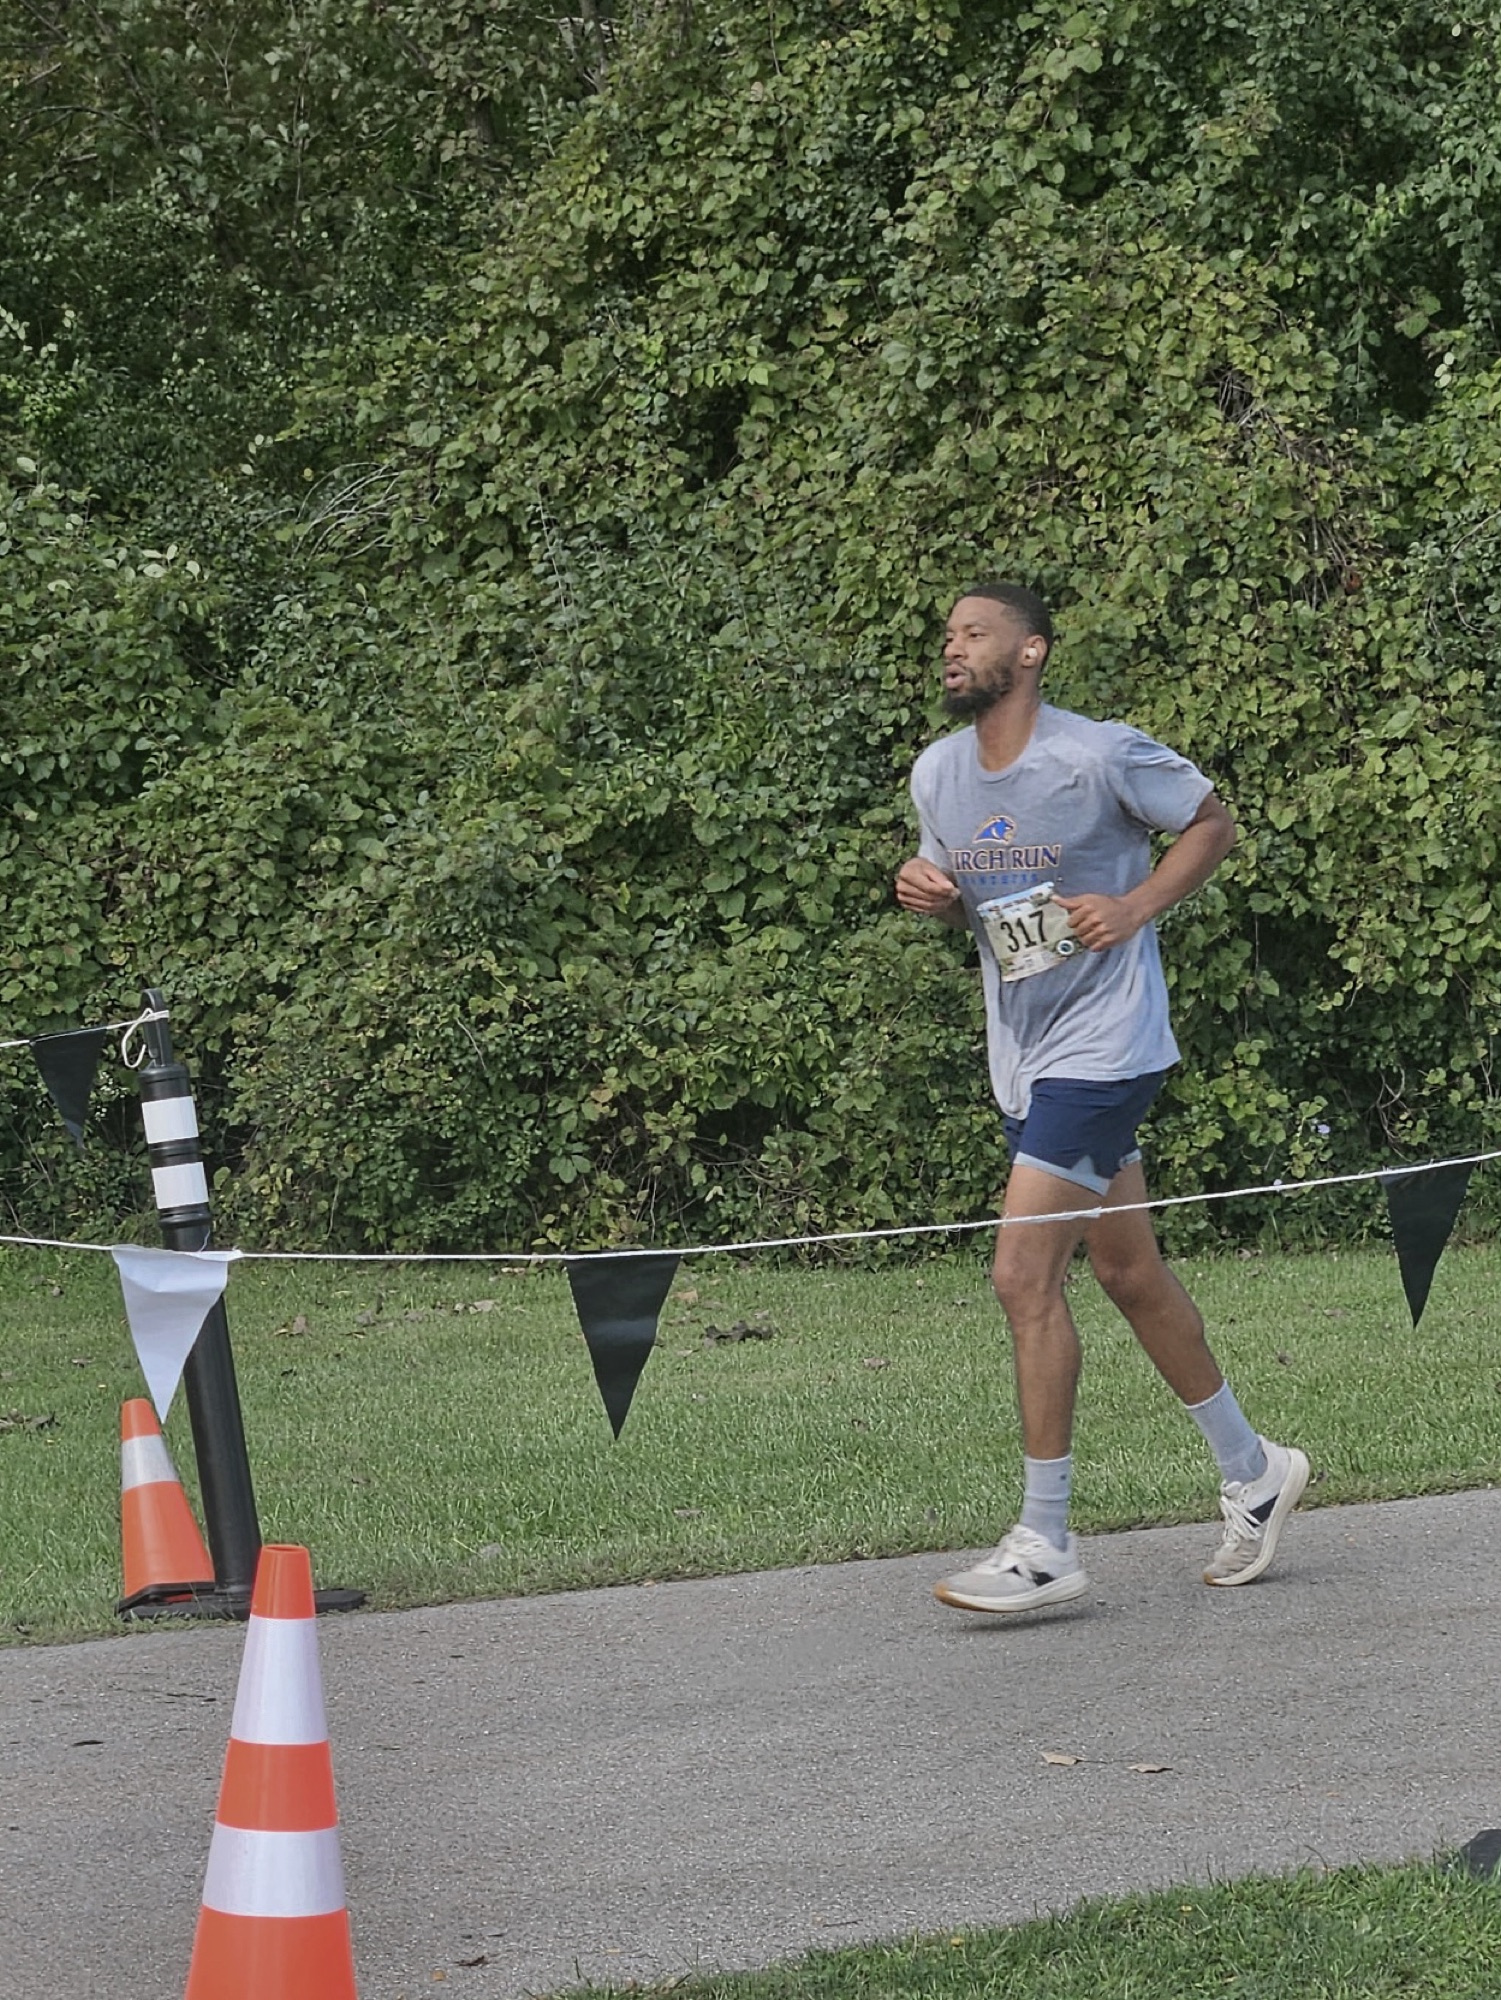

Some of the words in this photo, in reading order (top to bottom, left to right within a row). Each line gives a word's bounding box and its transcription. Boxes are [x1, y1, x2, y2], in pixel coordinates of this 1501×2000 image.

[948, 847, 1007, 871] IRCH
[1010, 845, 1061, 869] RUN
[1000, 910, 1048, 953] 317
